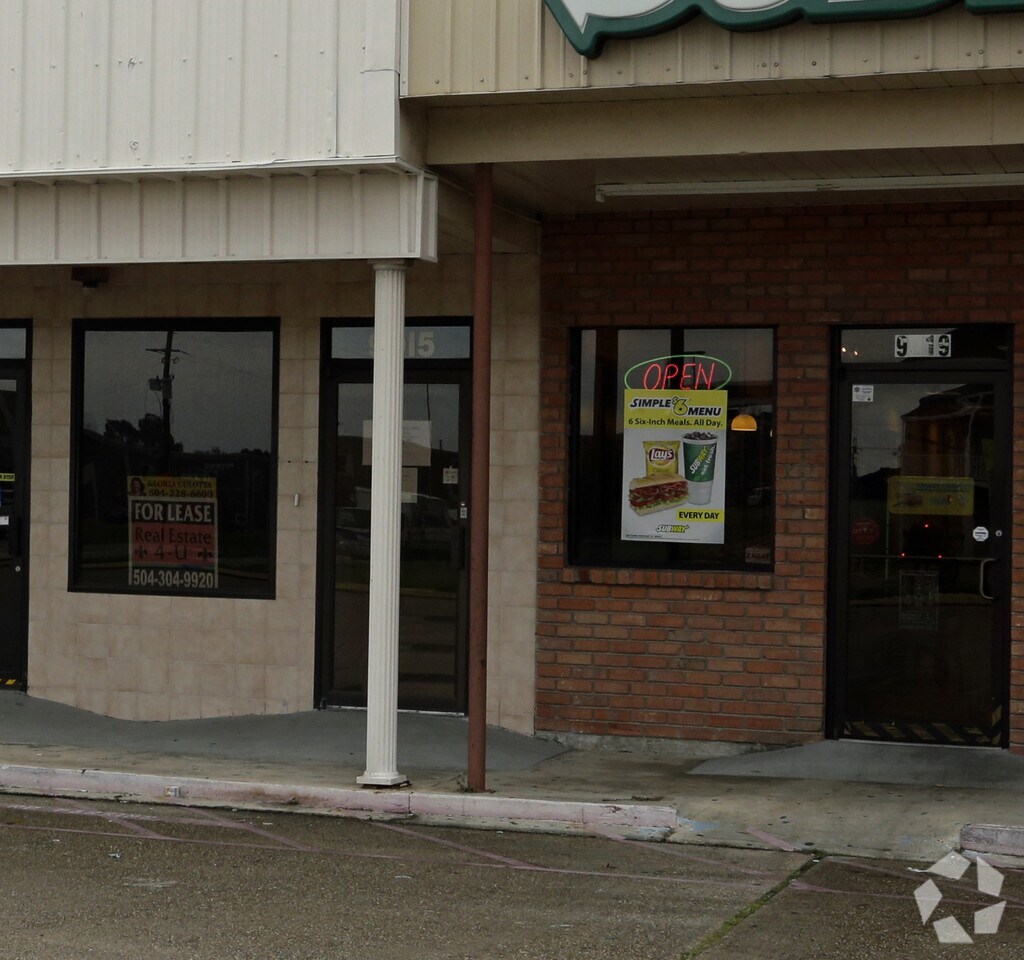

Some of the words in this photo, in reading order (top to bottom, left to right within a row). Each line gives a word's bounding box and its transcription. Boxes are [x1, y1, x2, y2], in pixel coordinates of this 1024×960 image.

[643, 362, 716, 390] OPEN
[630, 398, 672, 408] SIMPLE
[687, 407, 721, 416] MENU
[635, 417, 666, 425] Six-Inch
[667, 418, 692, 426] Meals.
[694, 418, 705, 426] All
[705, 419, 723, 428] Day.
[689, 446, 709, 474] SUBWAY
[147, 480, 176, 488] GLORIA
[178, 480, 212, 489] CULOTTA
[134, 502, 163, 520] FOR
[167, 503, 212, 522] LEASE
[678, 511, 703, 519] EVERY
[704, 512, 720, 520] DAY
[135, 526, 164, 542] Real
[168, 527, 212, 544] Estate
[656, 524, 688, 533] SUBWAY
[154, 544, 187, 560] 4-U
[133, 568, 214, 588] 504-304-9920
